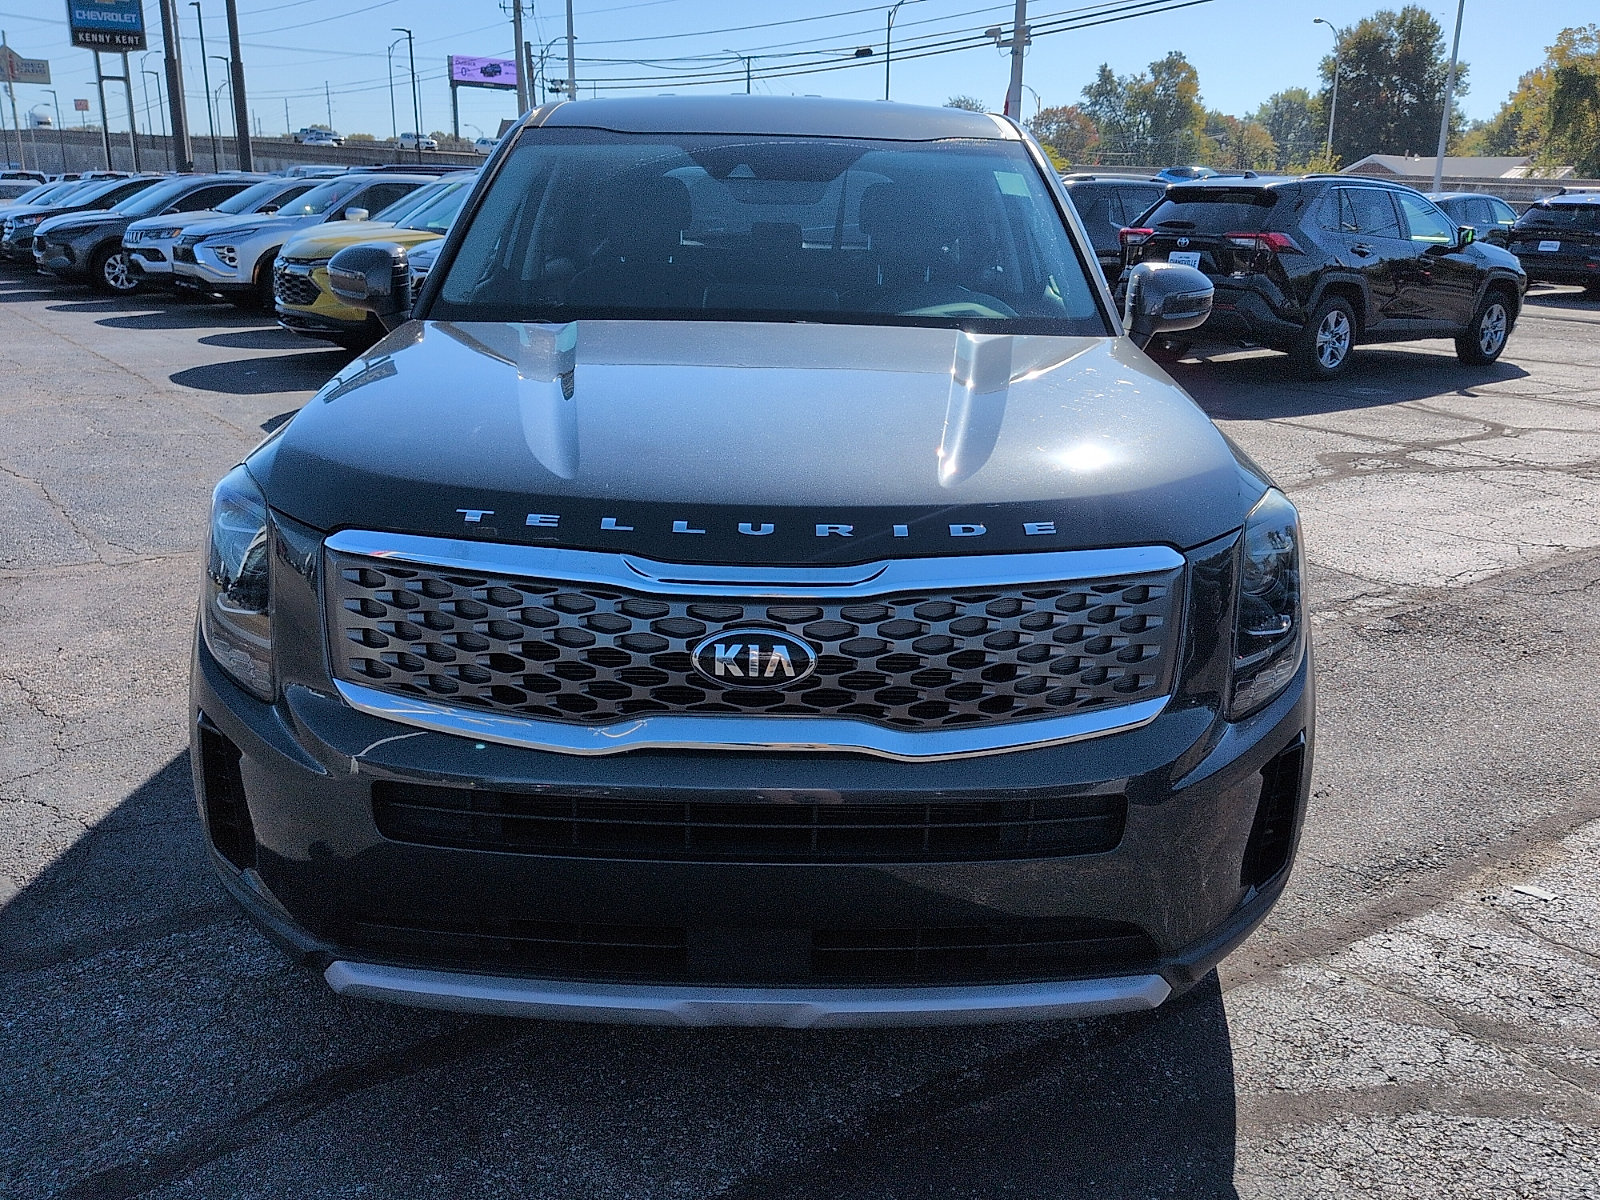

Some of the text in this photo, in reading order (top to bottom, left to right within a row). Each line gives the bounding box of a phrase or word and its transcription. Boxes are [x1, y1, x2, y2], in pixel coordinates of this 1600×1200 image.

[75, 10, 137, 23] CHEVROLET
[78, 32, 140, 45] KENNY KENT
[455, 508, 1057, 537] TELLURIDE
[714, 643, 796, 677] KIA
